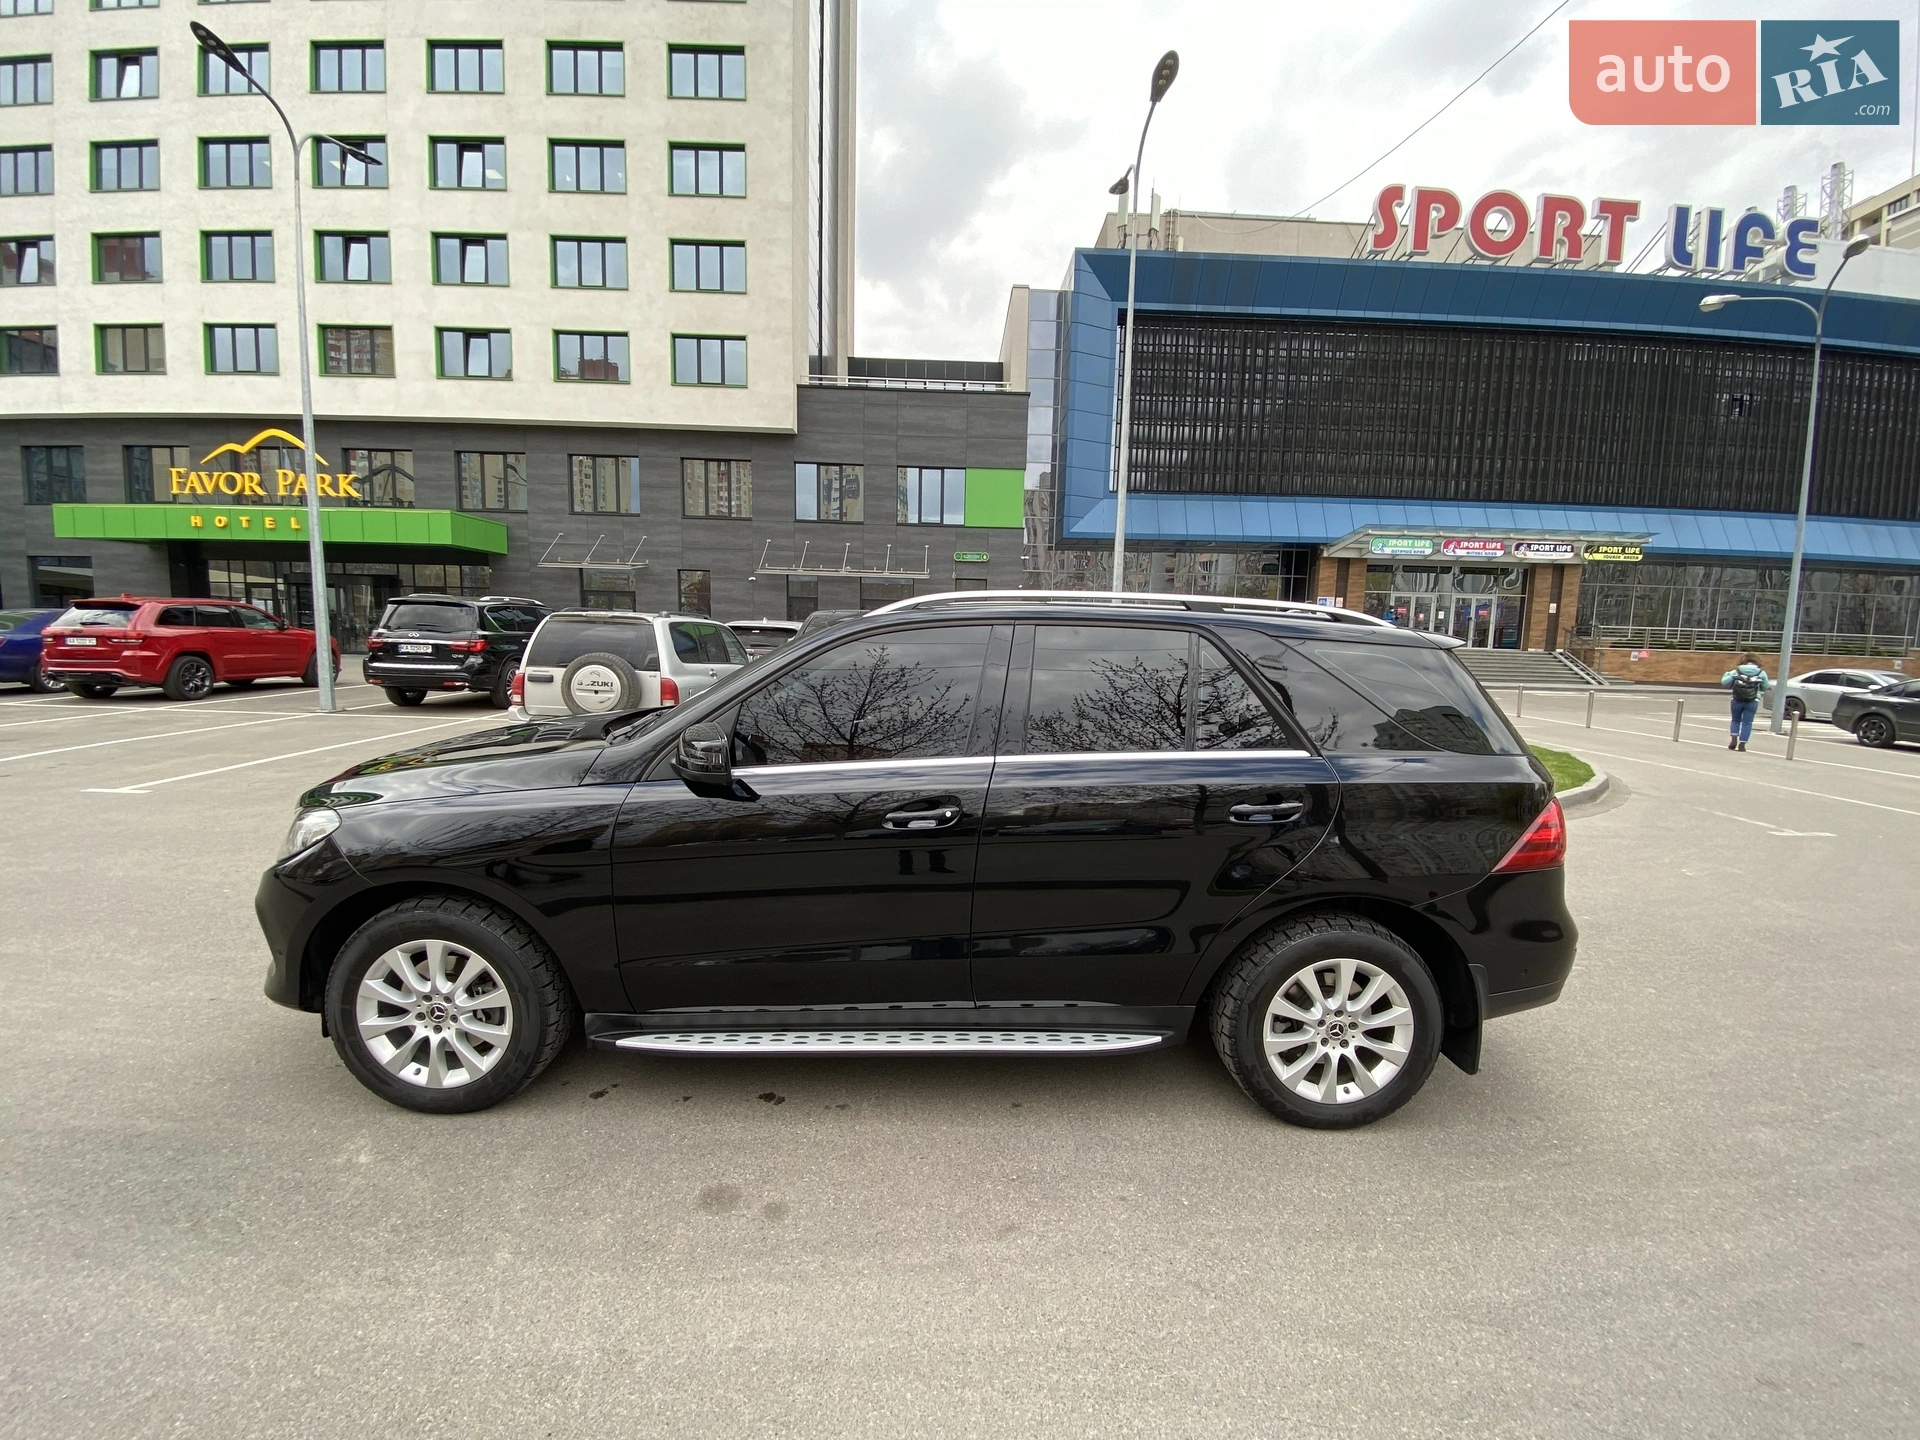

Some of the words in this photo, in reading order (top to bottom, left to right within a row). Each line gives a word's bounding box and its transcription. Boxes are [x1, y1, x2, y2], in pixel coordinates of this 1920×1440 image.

[1368, 184, 1641, 266] SPORT
[1666, 203, 1820, 282] LIFE
[169, 467, 268, 496] FAVOR
[275, 469, 363, 499] PARK
[190, 515, 301, 530] HOTEL
[1389, 539, 1413, 547] SPORT
[1460, 541, 1484, 549] SPORT
[1530, 544, 1555, 552] SPORT
[1556, 544, 1572, 552] LIFE
